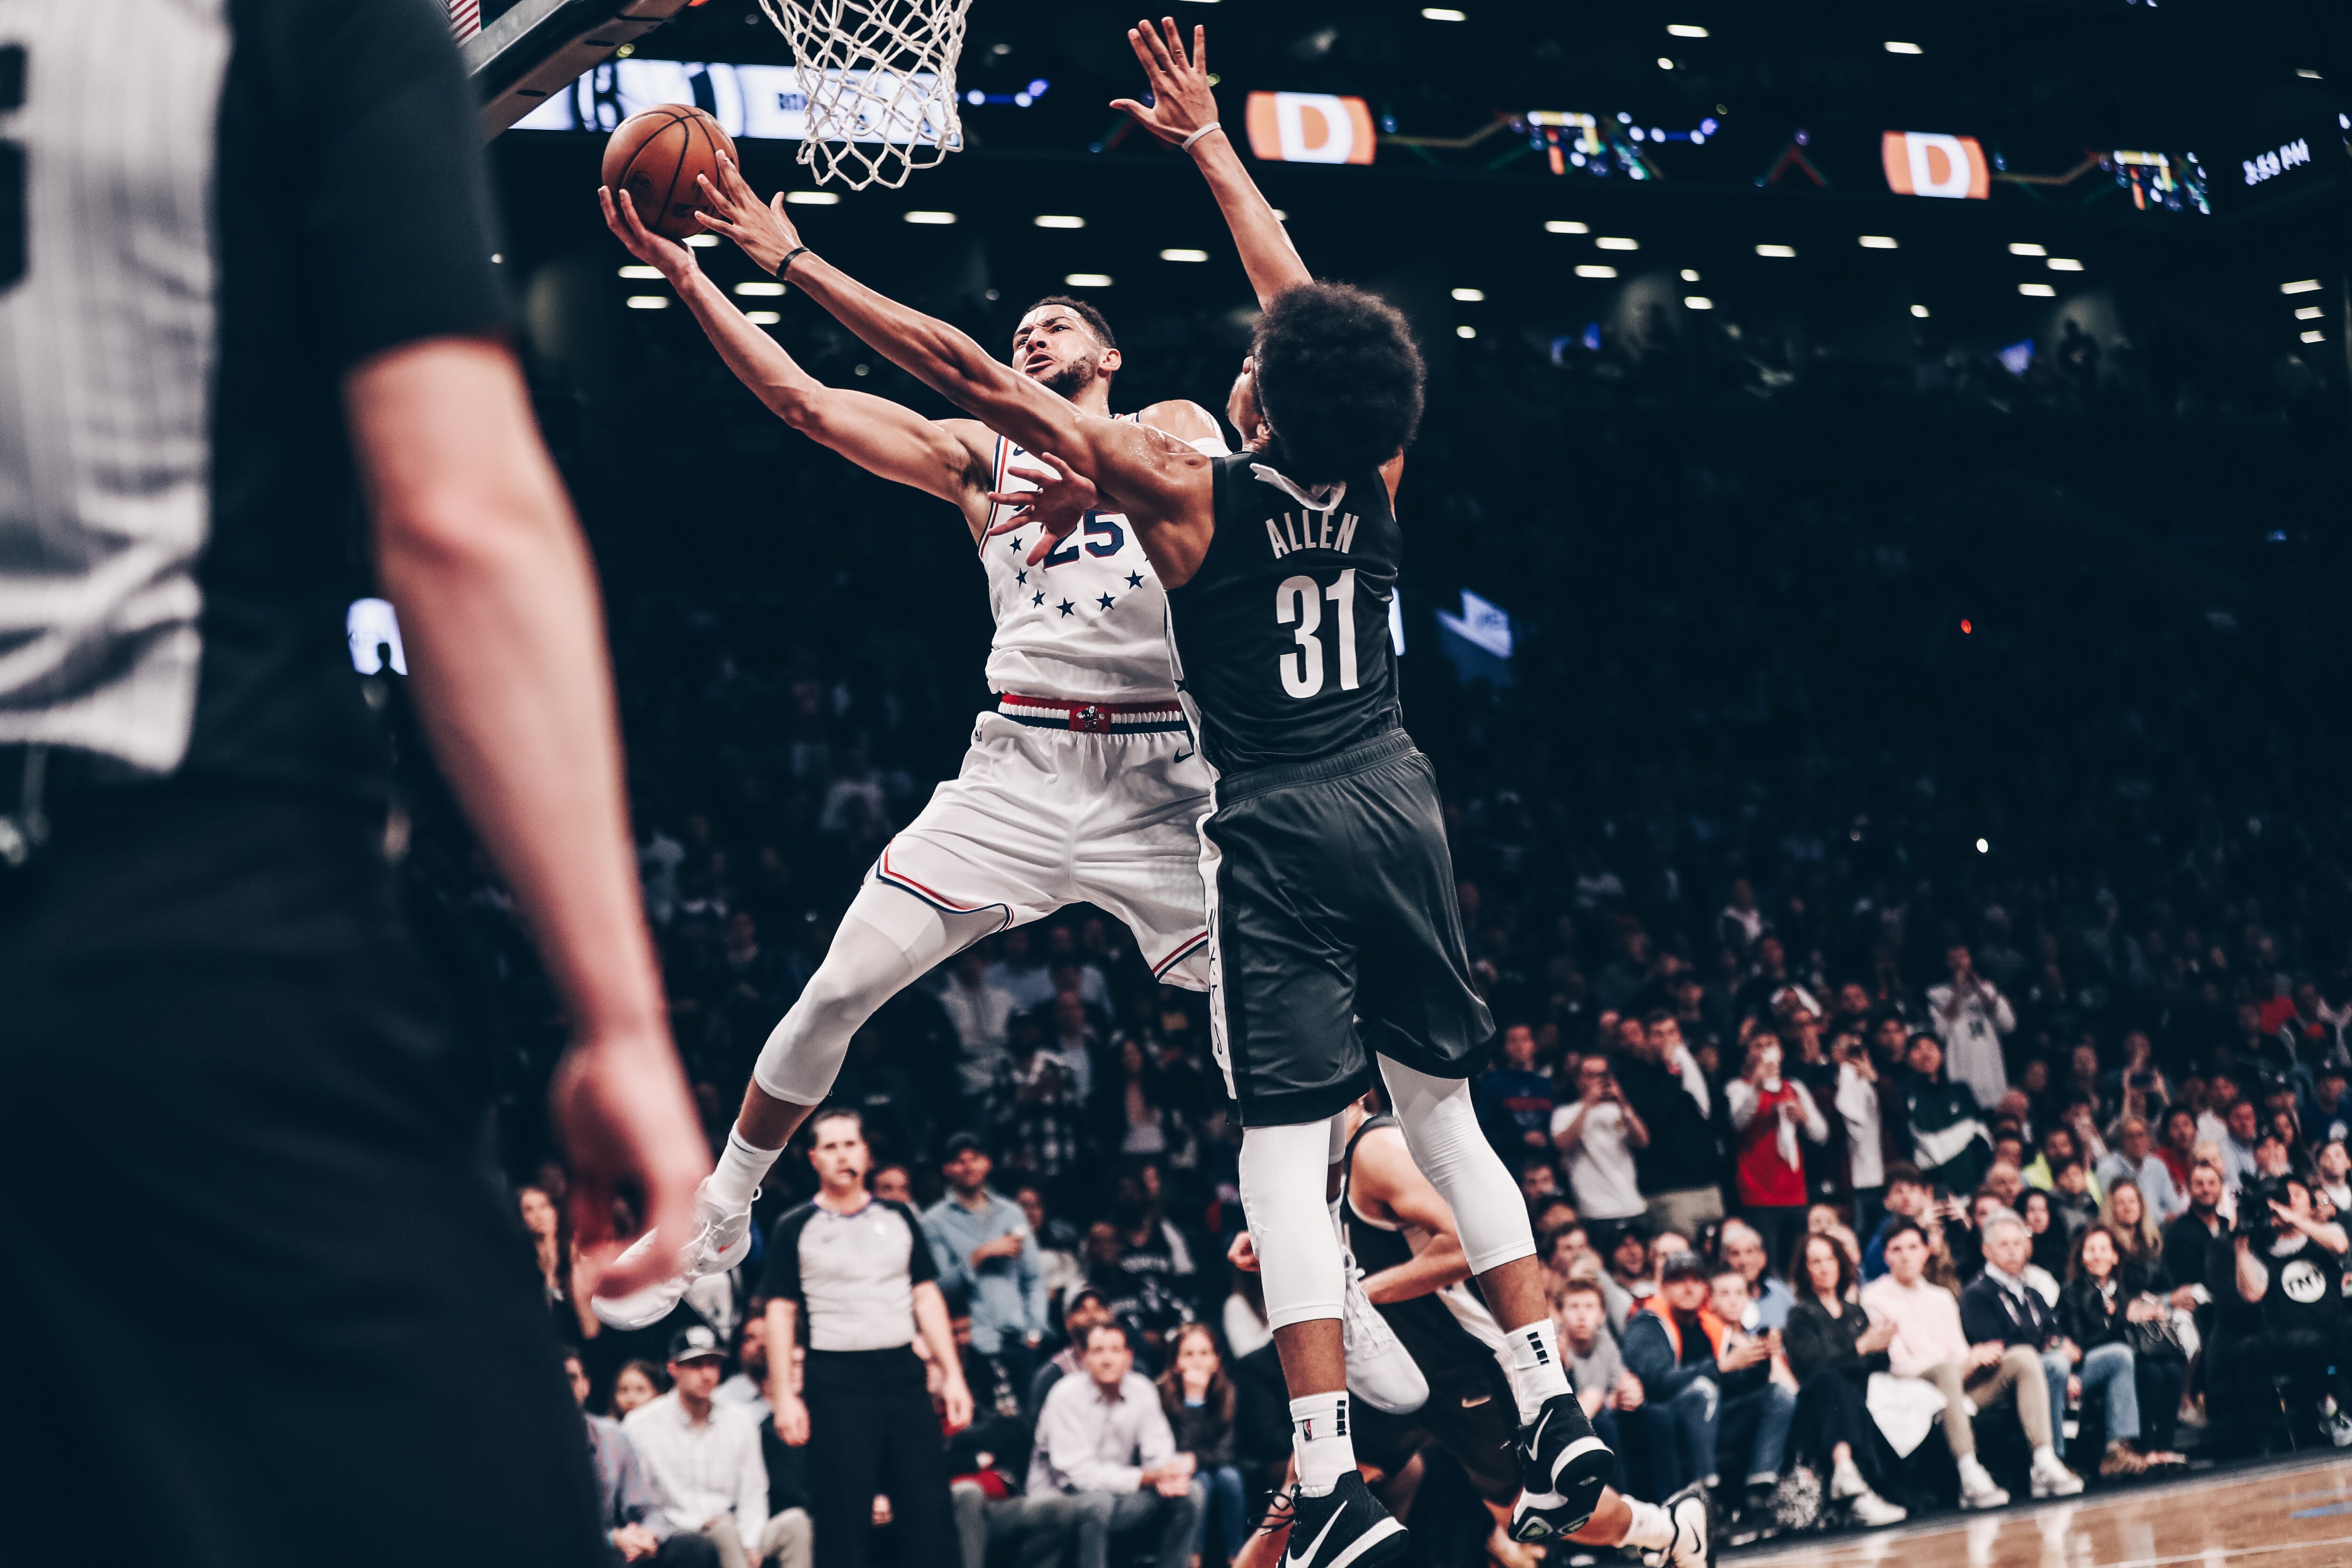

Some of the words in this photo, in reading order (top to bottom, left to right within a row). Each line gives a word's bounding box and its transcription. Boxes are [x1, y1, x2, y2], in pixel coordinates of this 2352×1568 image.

[1275, 91, 1353, 164] D
[1905, 131, 1971, 199] D
[1043, 509, 1124, 570] 25
[1265, 509, 1359, 559] ALLEN
[1276, 568, 1359, 699] 31
